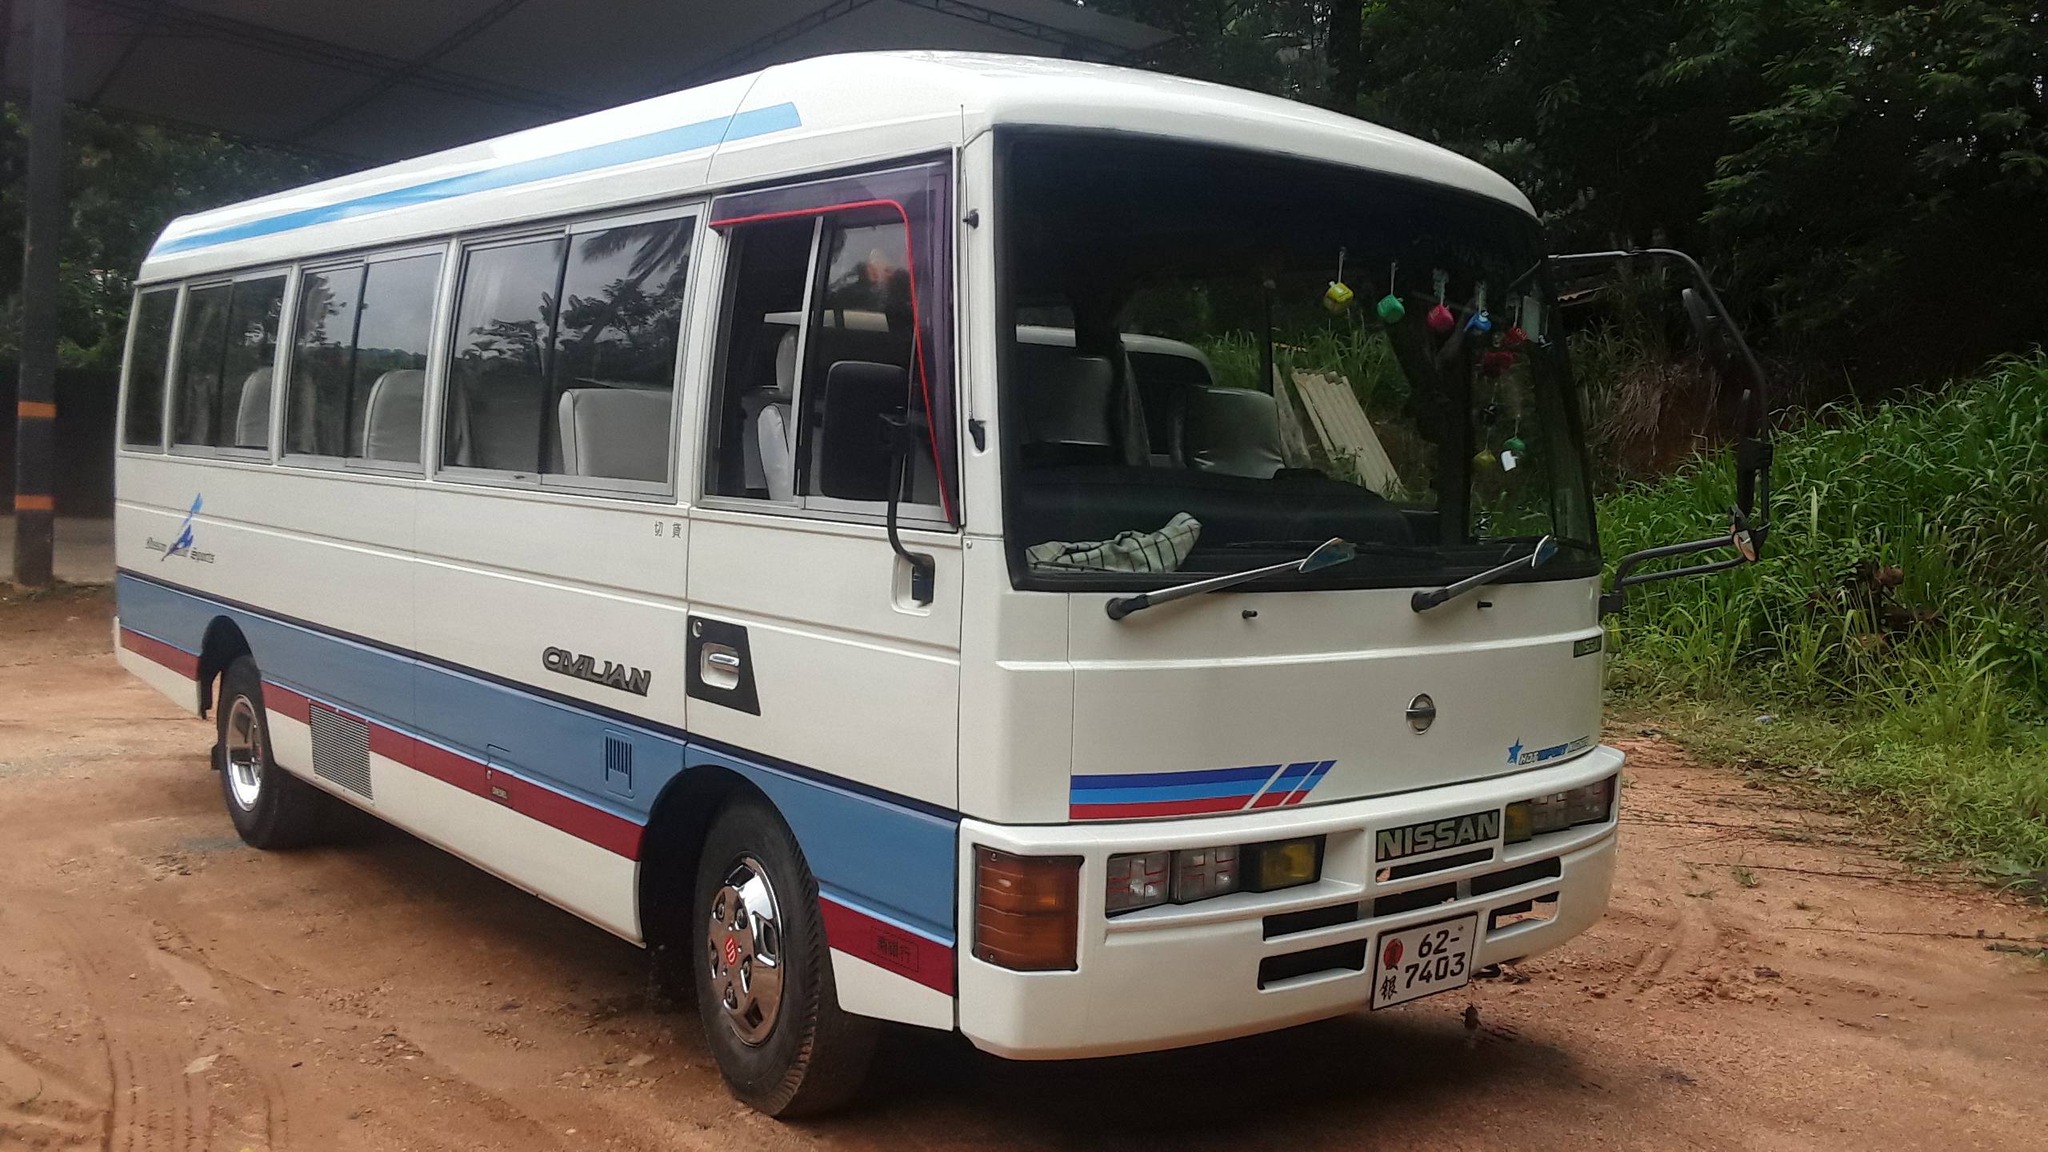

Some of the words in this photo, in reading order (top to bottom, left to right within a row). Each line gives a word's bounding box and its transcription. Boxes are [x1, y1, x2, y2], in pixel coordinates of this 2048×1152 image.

[543, 646, 651, 697] CIVILIAN
[1376, 811, 1499, 861] NISSAN
[1418, 929, 1460, 959] 62-
[1405, 952, 1466, 989] 7403
